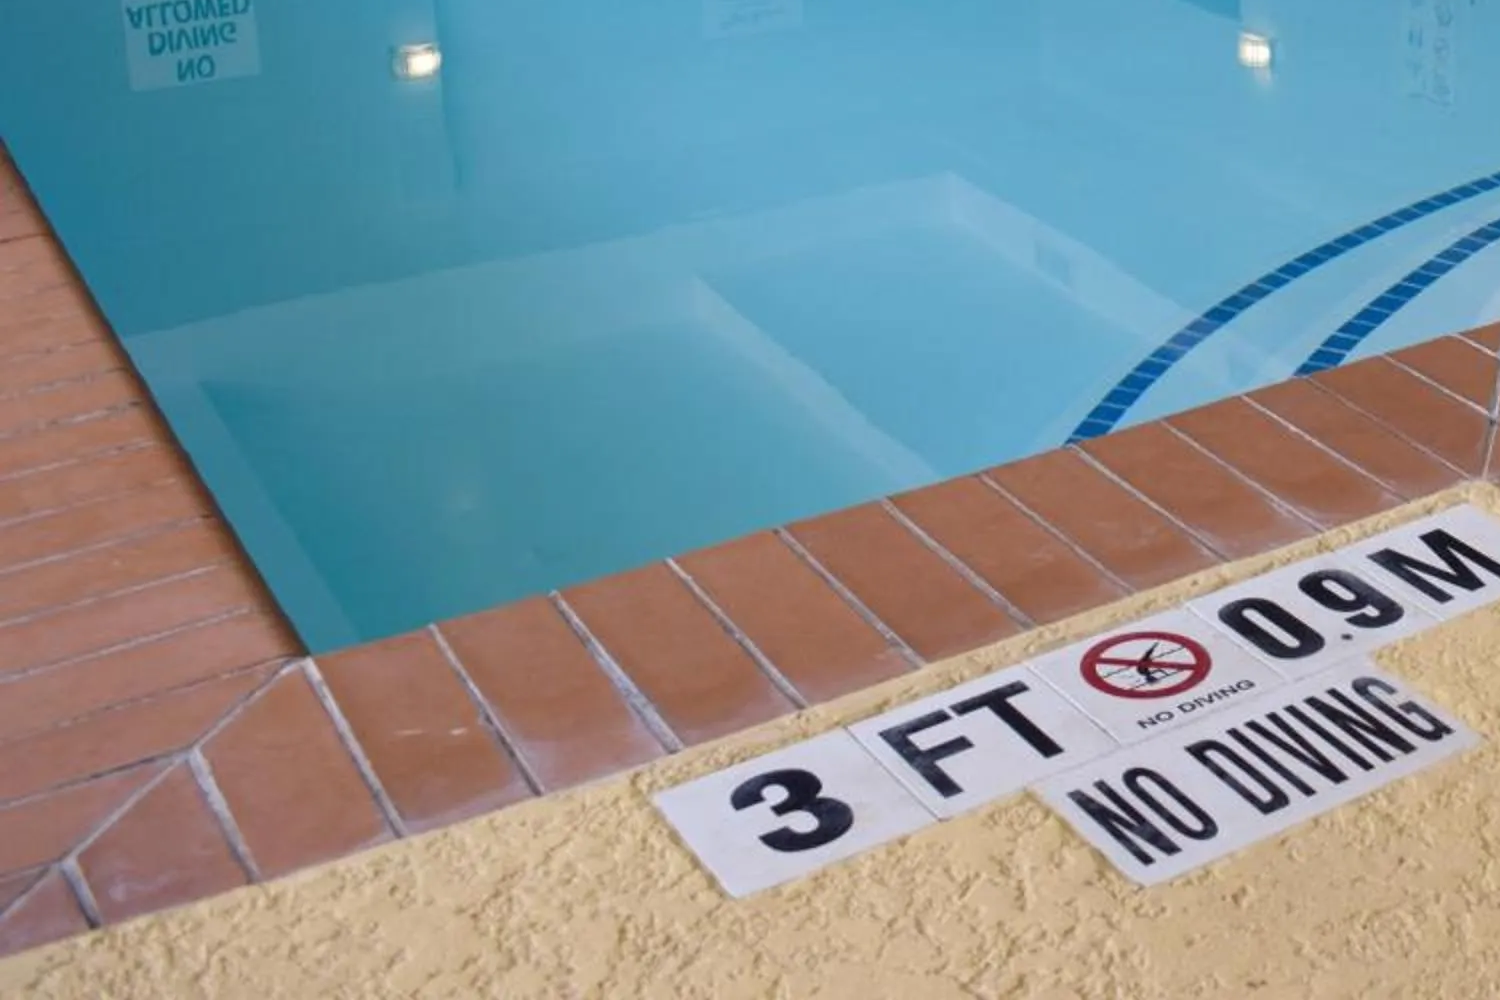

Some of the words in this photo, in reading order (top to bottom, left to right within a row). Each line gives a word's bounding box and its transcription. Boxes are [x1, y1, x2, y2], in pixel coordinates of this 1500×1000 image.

[729, 768, 854, 853] 3
[879, 680, 1065, 798] FT
[1067, 766, 1219, 867] NO
[1184, 676, 1456, 816] DIVING
[1136, 709, 1175, 730] NO
[1178, 678, 1256, 714] DIVING
